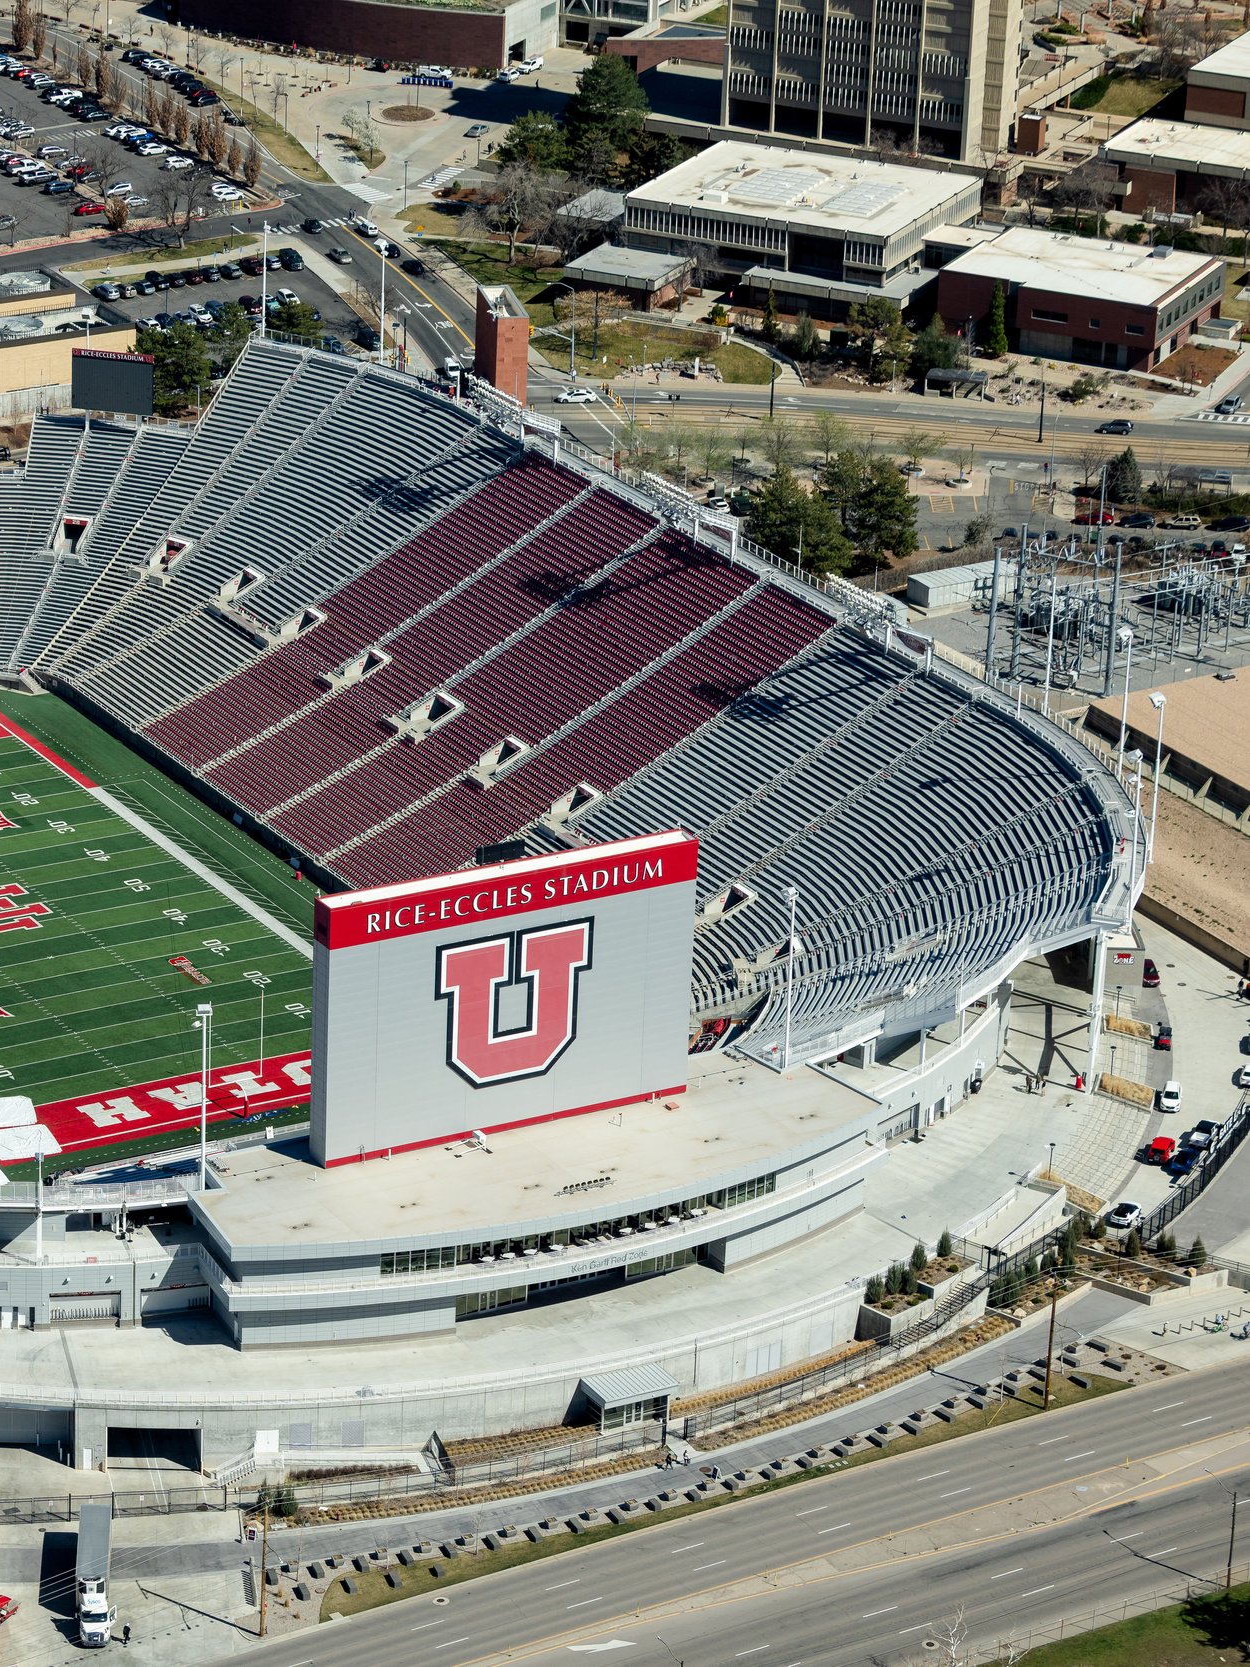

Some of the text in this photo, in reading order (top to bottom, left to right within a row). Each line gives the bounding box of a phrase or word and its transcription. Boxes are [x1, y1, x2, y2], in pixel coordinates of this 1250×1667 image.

[81, 350, 116, 359] RICE-ECCLES
[117, 353, 144, 361] STADIUM
[13, 793, 39, 806] 20
[49, 820, 76, 834] 30
[85, 848, 111, 862] 40
[123, 878, 151, 892] 50
[367, 858, 664, 935] RICE-ECCLES STADIUM
[162, 908, 188, 922] 40
[202, 939, 230, 953] 30
[1113, 956, 1134, 965] ZONE
[242, 970, 272, 985] 20
[284, 1002, 312, 1016] 10
[434, 915, 595, 1090] U
[571, 1264, 587, 1273] Ken
[611, 1254, 627, 1264] Red
[629, 1250, 648, 1260] Zone
